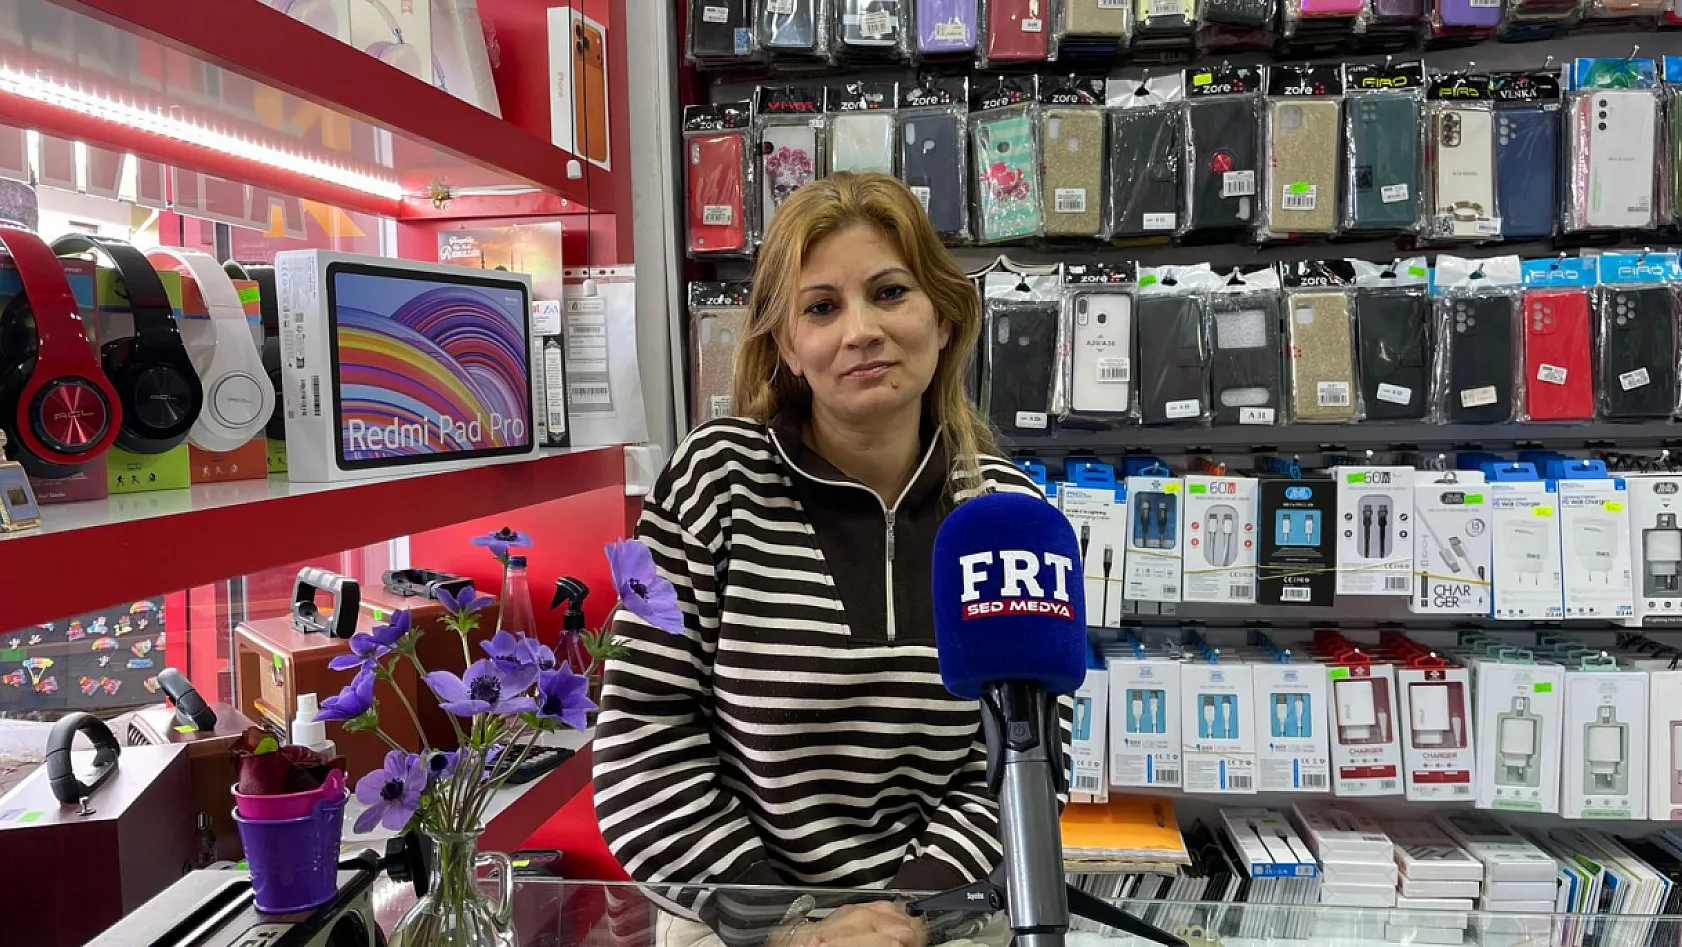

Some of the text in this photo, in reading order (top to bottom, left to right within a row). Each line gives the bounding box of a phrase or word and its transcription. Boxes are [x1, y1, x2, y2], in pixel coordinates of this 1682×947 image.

[1203, 84, 1231, 94] zore
[1284, 86, 1312, 95] zore
[913, 96, 938, 105] zore
[1052, 94, 1077, 103] zore
[983, 98, 1008, 110] zore
[349, 412, 523, 451] Redmi Pad Pro
[959, 549, 1073, 602] FRT
[1433, 596, 1460, 608] GER
[967, 600, 1070, 618] SED MEDYA
[1349, 747, 1384, 755] CHARGER
[1422, 752, 1458, 760] CHARGER
